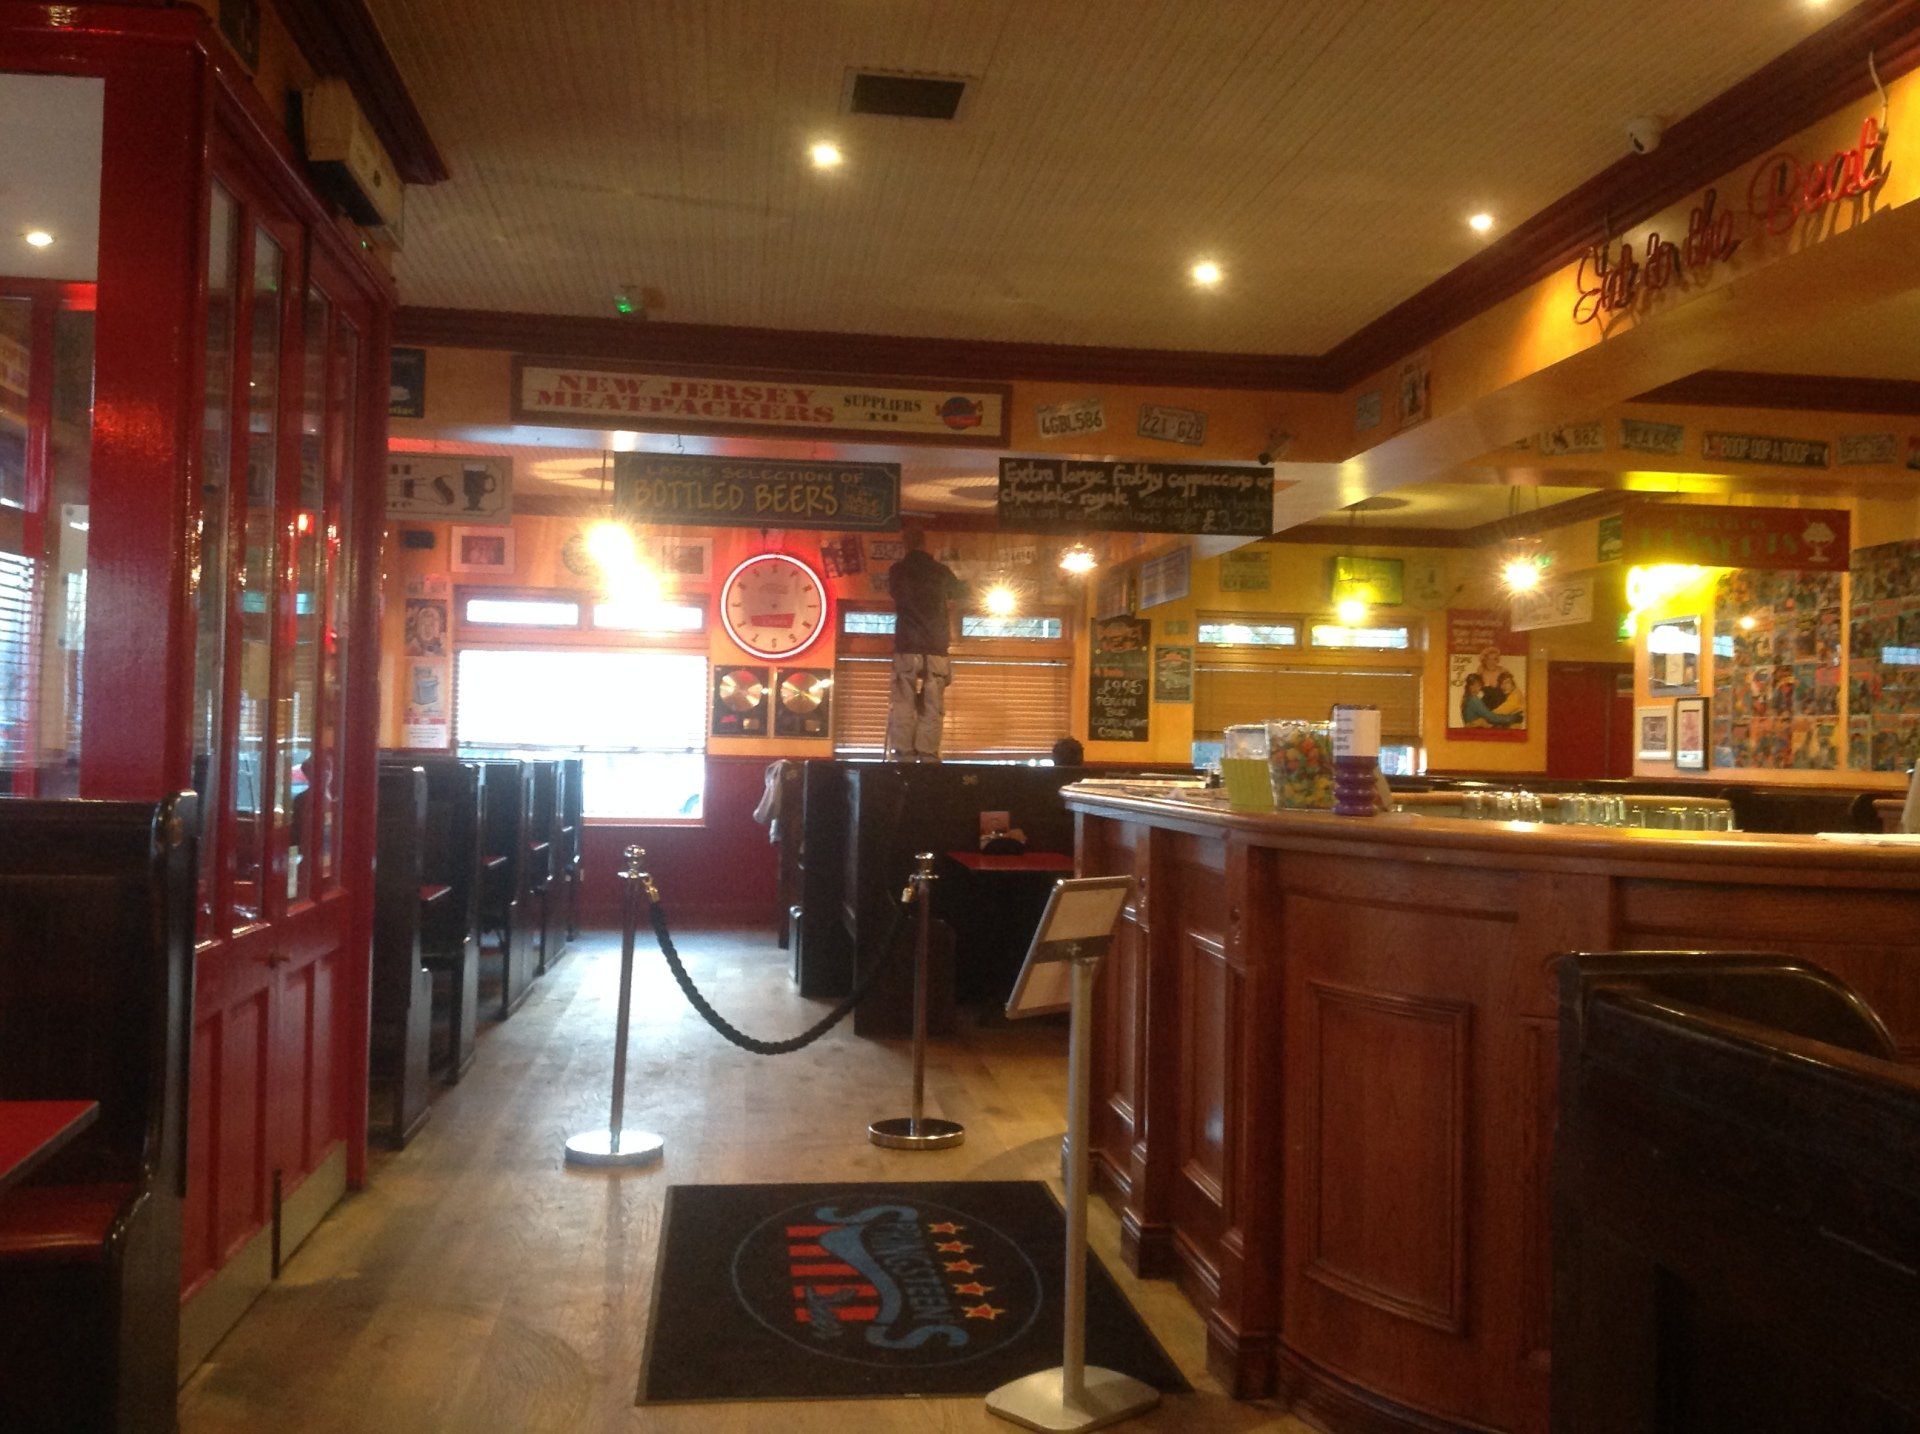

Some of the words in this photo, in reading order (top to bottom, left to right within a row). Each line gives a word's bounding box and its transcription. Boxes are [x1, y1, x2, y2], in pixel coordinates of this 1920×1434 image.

[1747, 117, 1884, 236] Beat
[558, 374, 648, 395] NEW
[661, 381, 816, 405] JERSEY
[843, 393, 922, 413] SUPPLIERS
[538, 389, 834, 424] MEATPACKERS
[722, 467, 832, 483] SELECTION
[841, 471, 864, 484] OF
[634, 478, 744, 512] BOTTLED
[754, 484, 839, 519] BEERS
